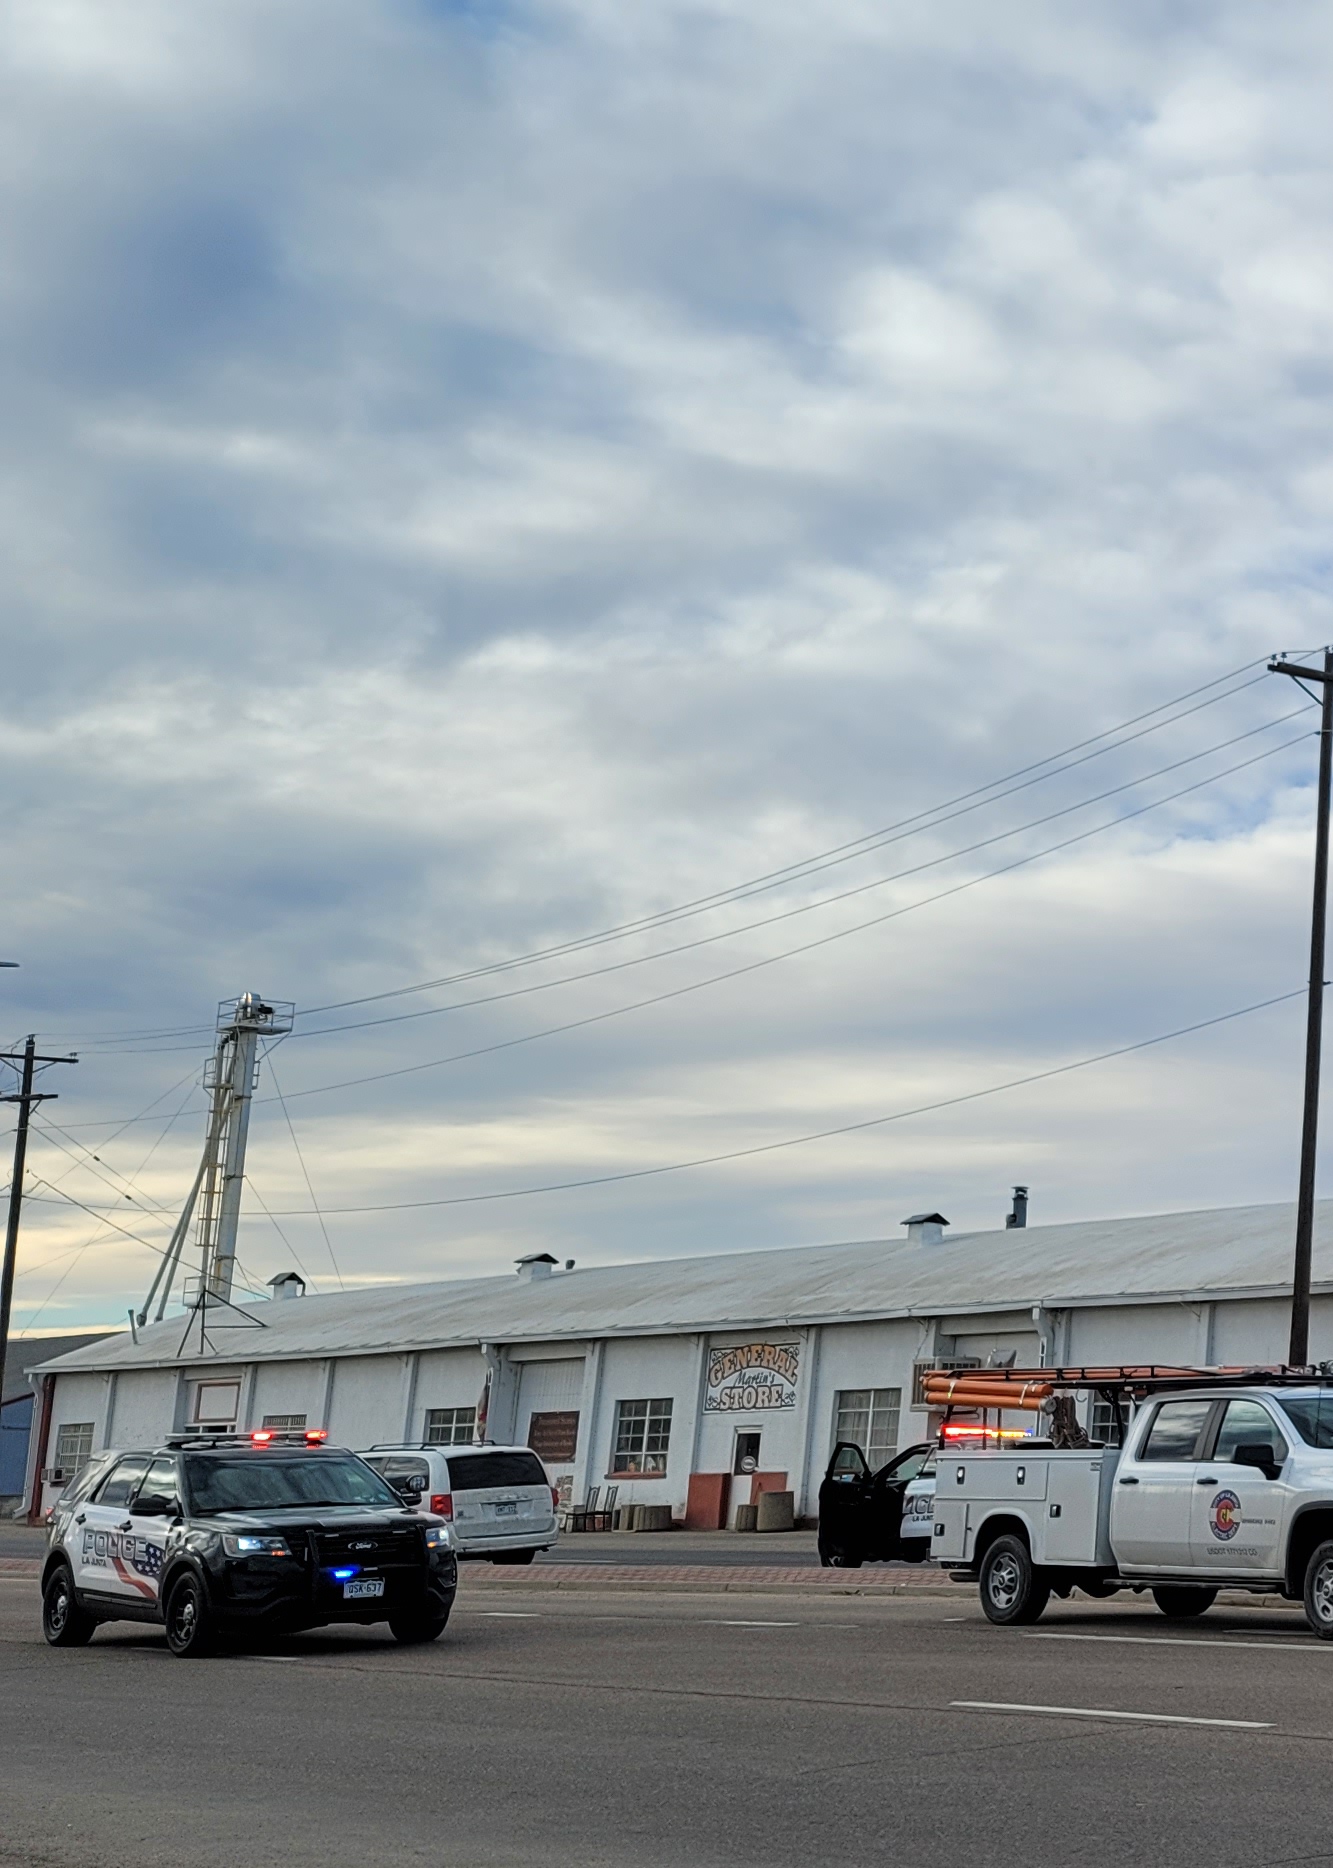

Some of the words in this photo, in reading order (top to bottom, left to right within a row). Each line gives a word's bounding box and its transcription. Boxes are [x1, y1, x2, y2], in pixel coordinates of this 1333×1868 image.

[709, 1343, 799, 1388] GENERAL
[734, 1371, 776, 1387] Martin's
[720, 1384, 784, 1411] STORE
[82, 1528, 147, 1562] POLICE
[82, 1556, 90, 1565] LA
